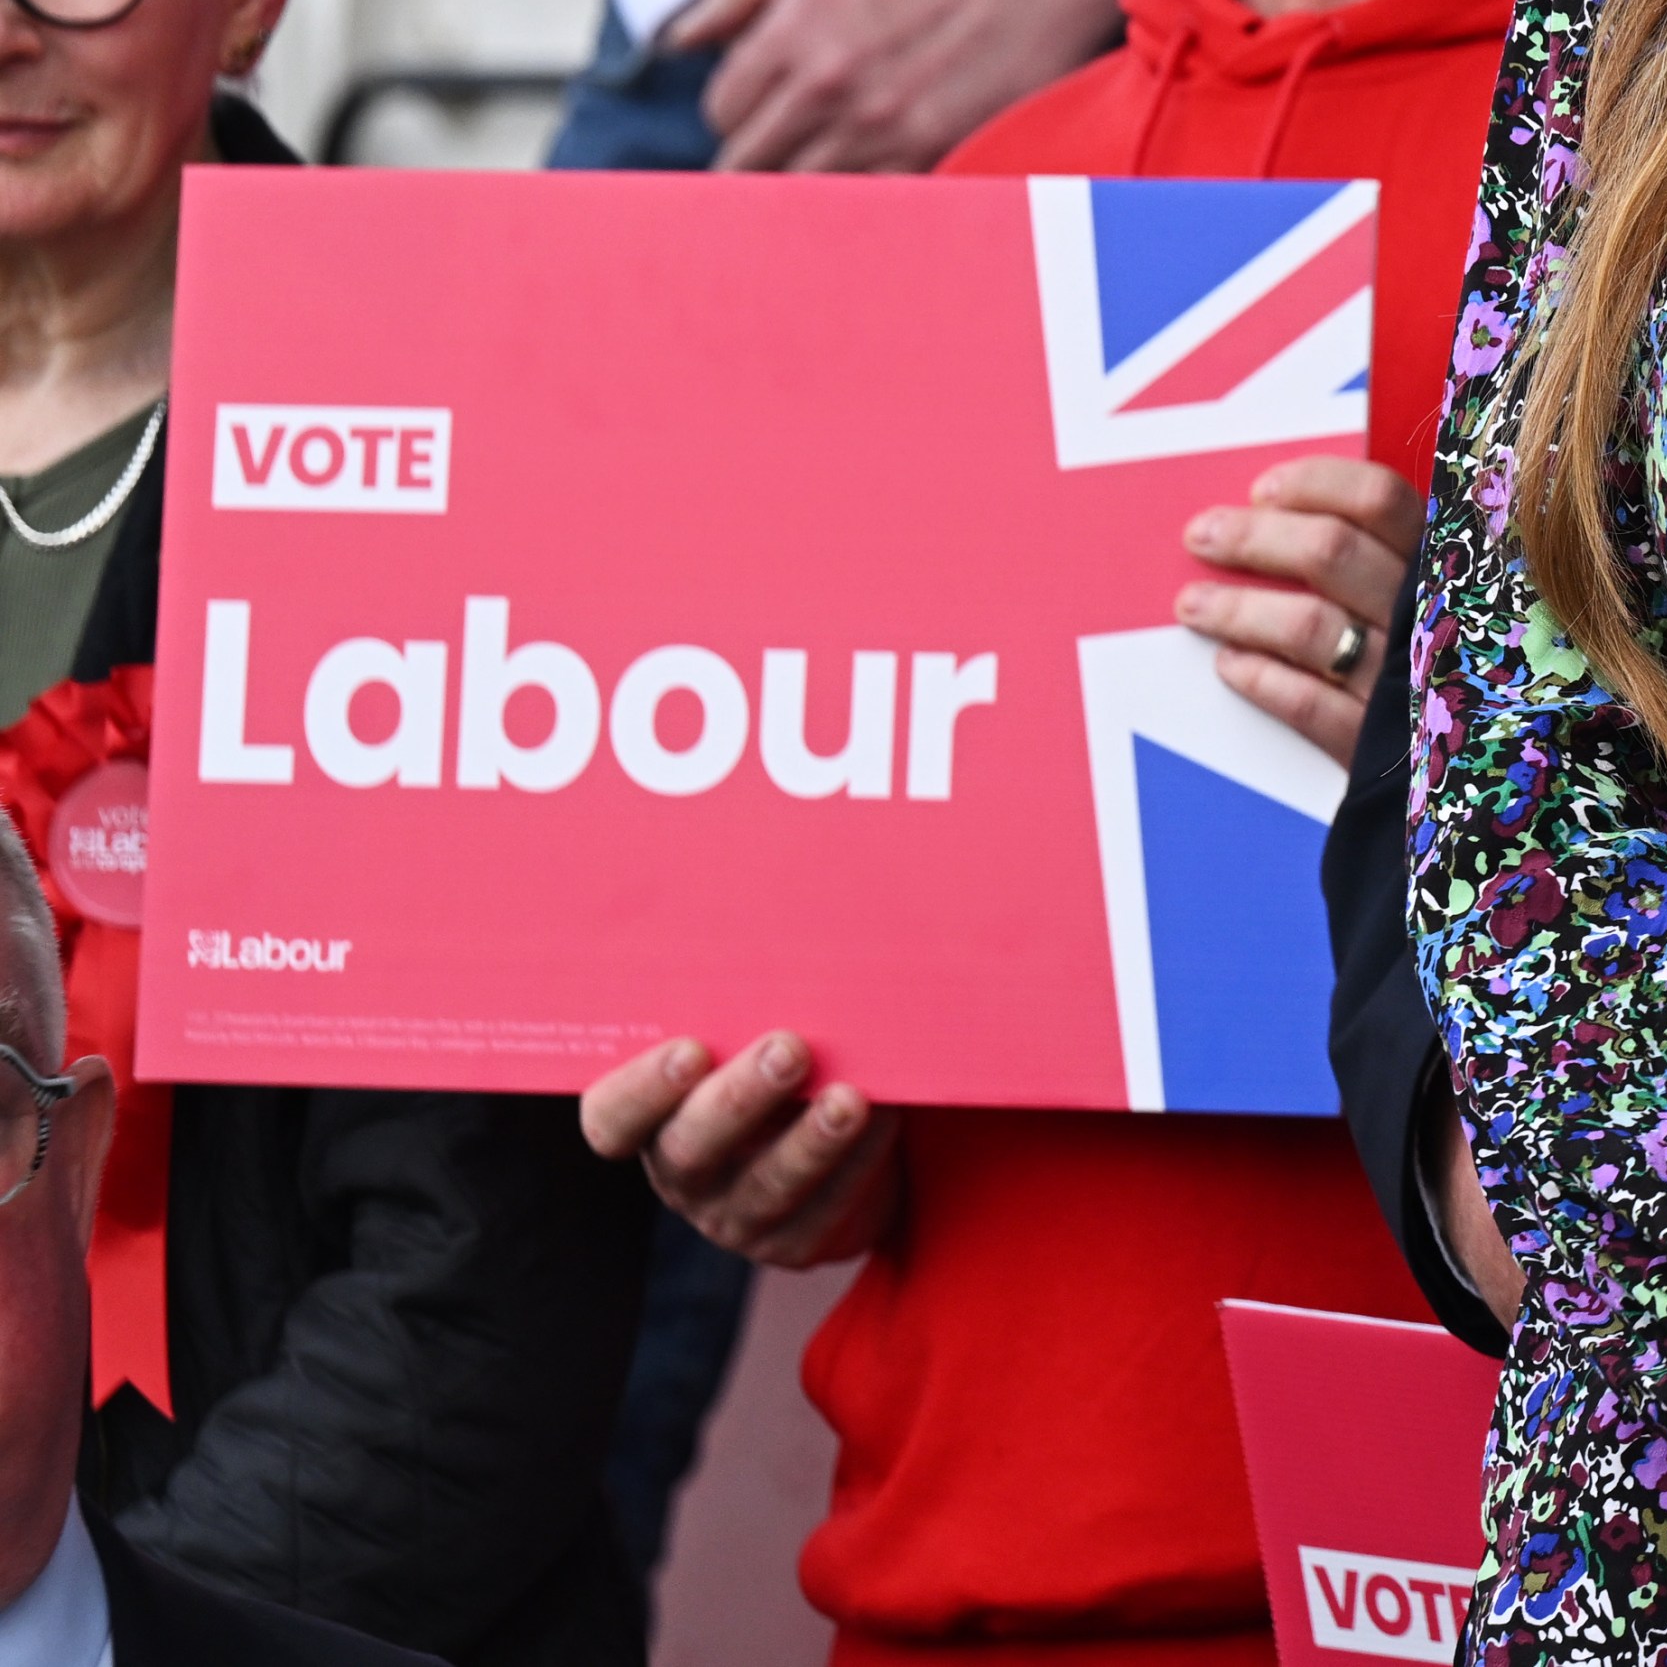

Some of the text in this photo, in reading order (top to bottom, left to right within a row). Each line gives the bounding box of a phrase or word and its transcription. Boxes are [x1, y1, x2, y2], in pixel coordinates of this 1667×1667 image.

[231, 423, 435, 489] VOTE
[199, 594, 998, 802] Labour
[221, 929, 353, 972] Labour
